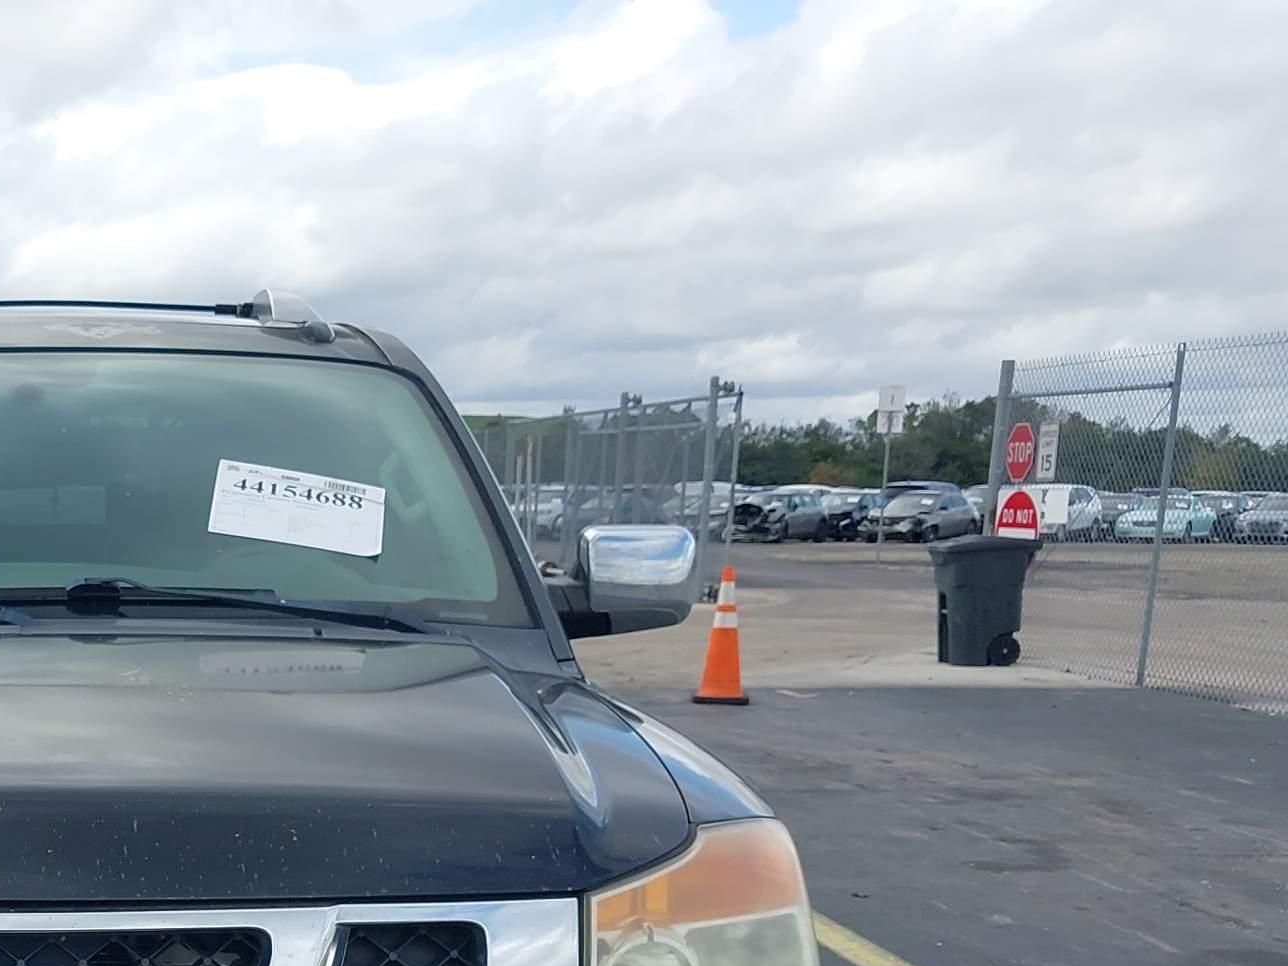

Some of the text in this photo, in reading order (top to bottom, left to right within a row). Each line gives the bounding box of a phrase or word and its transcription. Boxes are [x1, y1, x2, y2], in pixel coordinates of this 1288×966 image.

[1007, 441, 1032, 464] STOP
[1040, 454, 1053, 473] 15
[233, 478, 363, 510] 44154688
[1002, 508, 1034, 524] DO NOT
